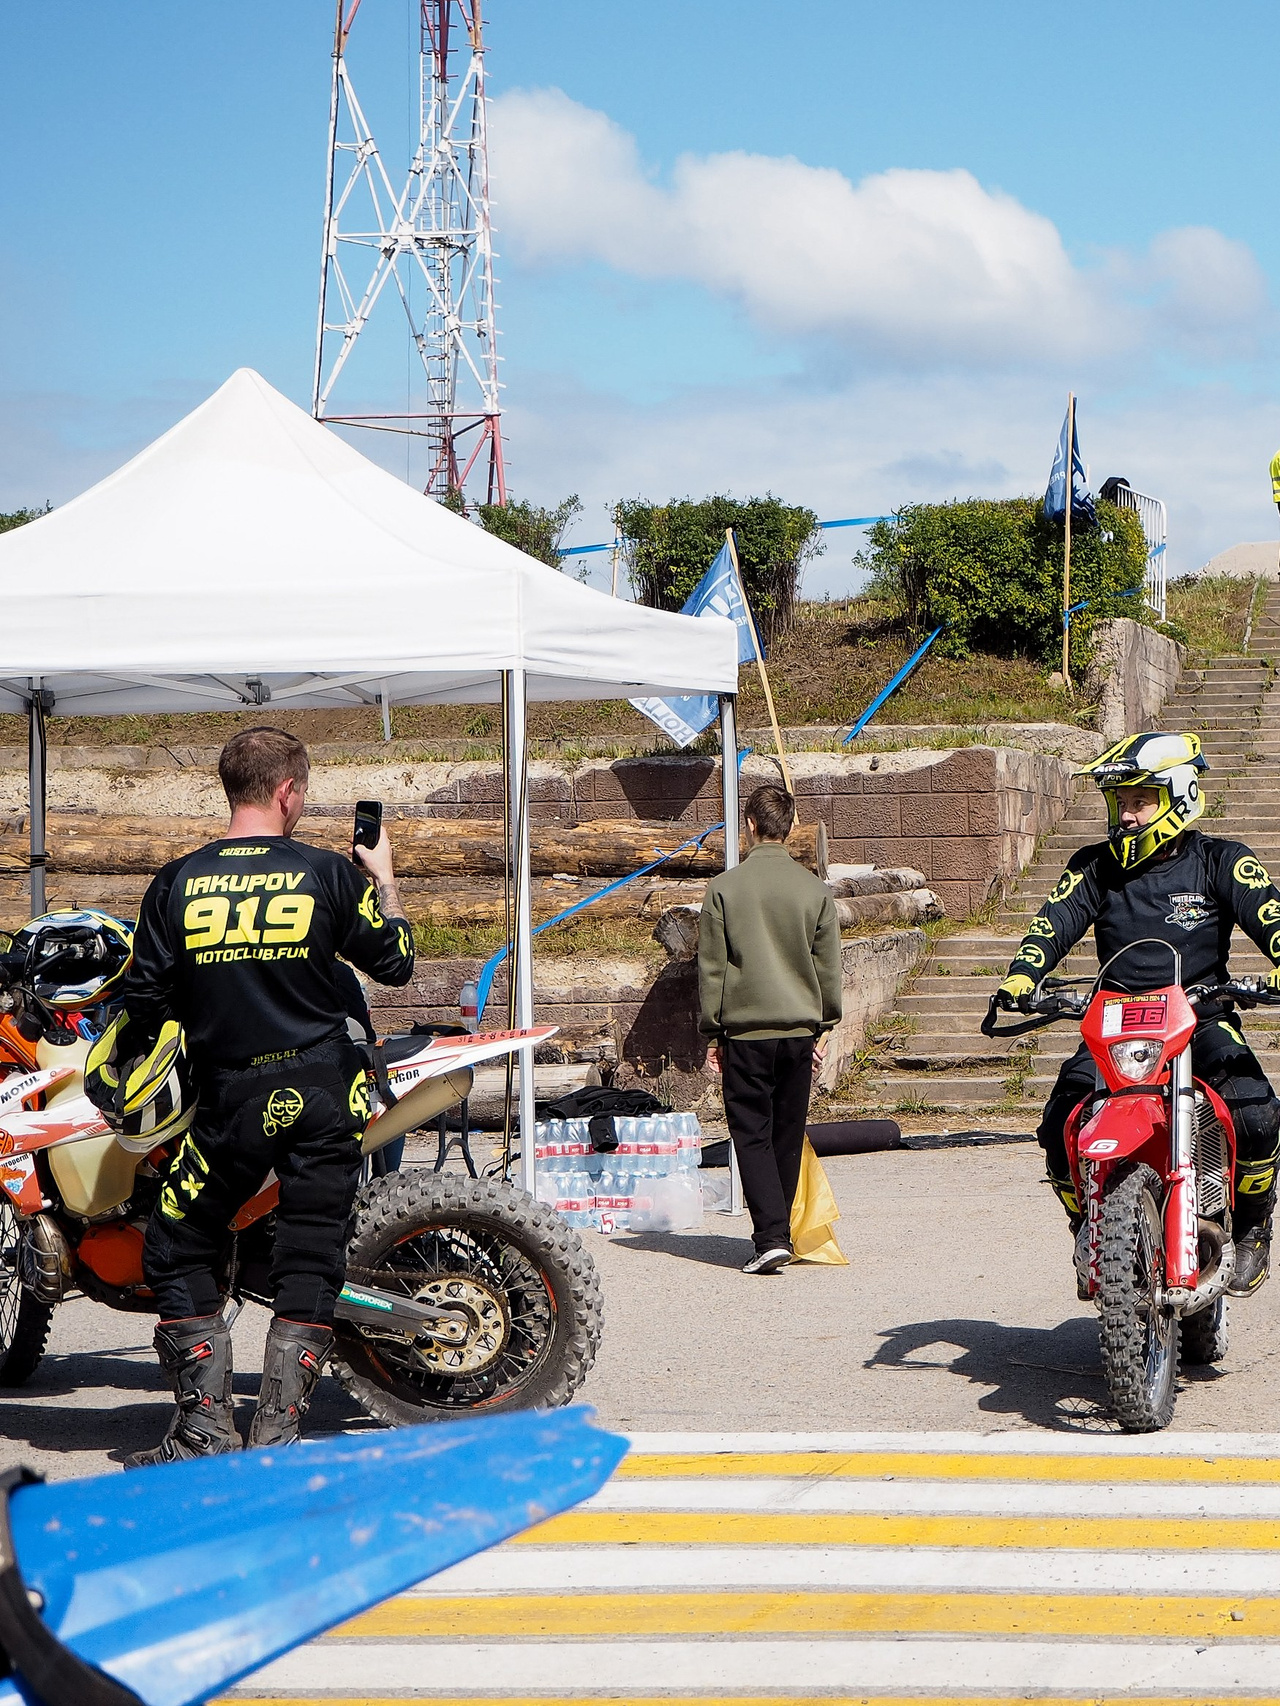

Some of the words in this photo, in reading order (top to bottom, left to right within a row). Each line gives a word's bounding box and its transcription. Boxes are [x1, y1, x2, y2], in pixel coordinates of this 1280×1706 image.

[184, 872, 306, 897] IAKUPOV
[183, 894, 316, 950] 919
[1122, 1007, 1164, 1026] 36
[0, 1075, 41, 1104] MOTUL
[350, 1290, 392, 1310] MOTOREX
